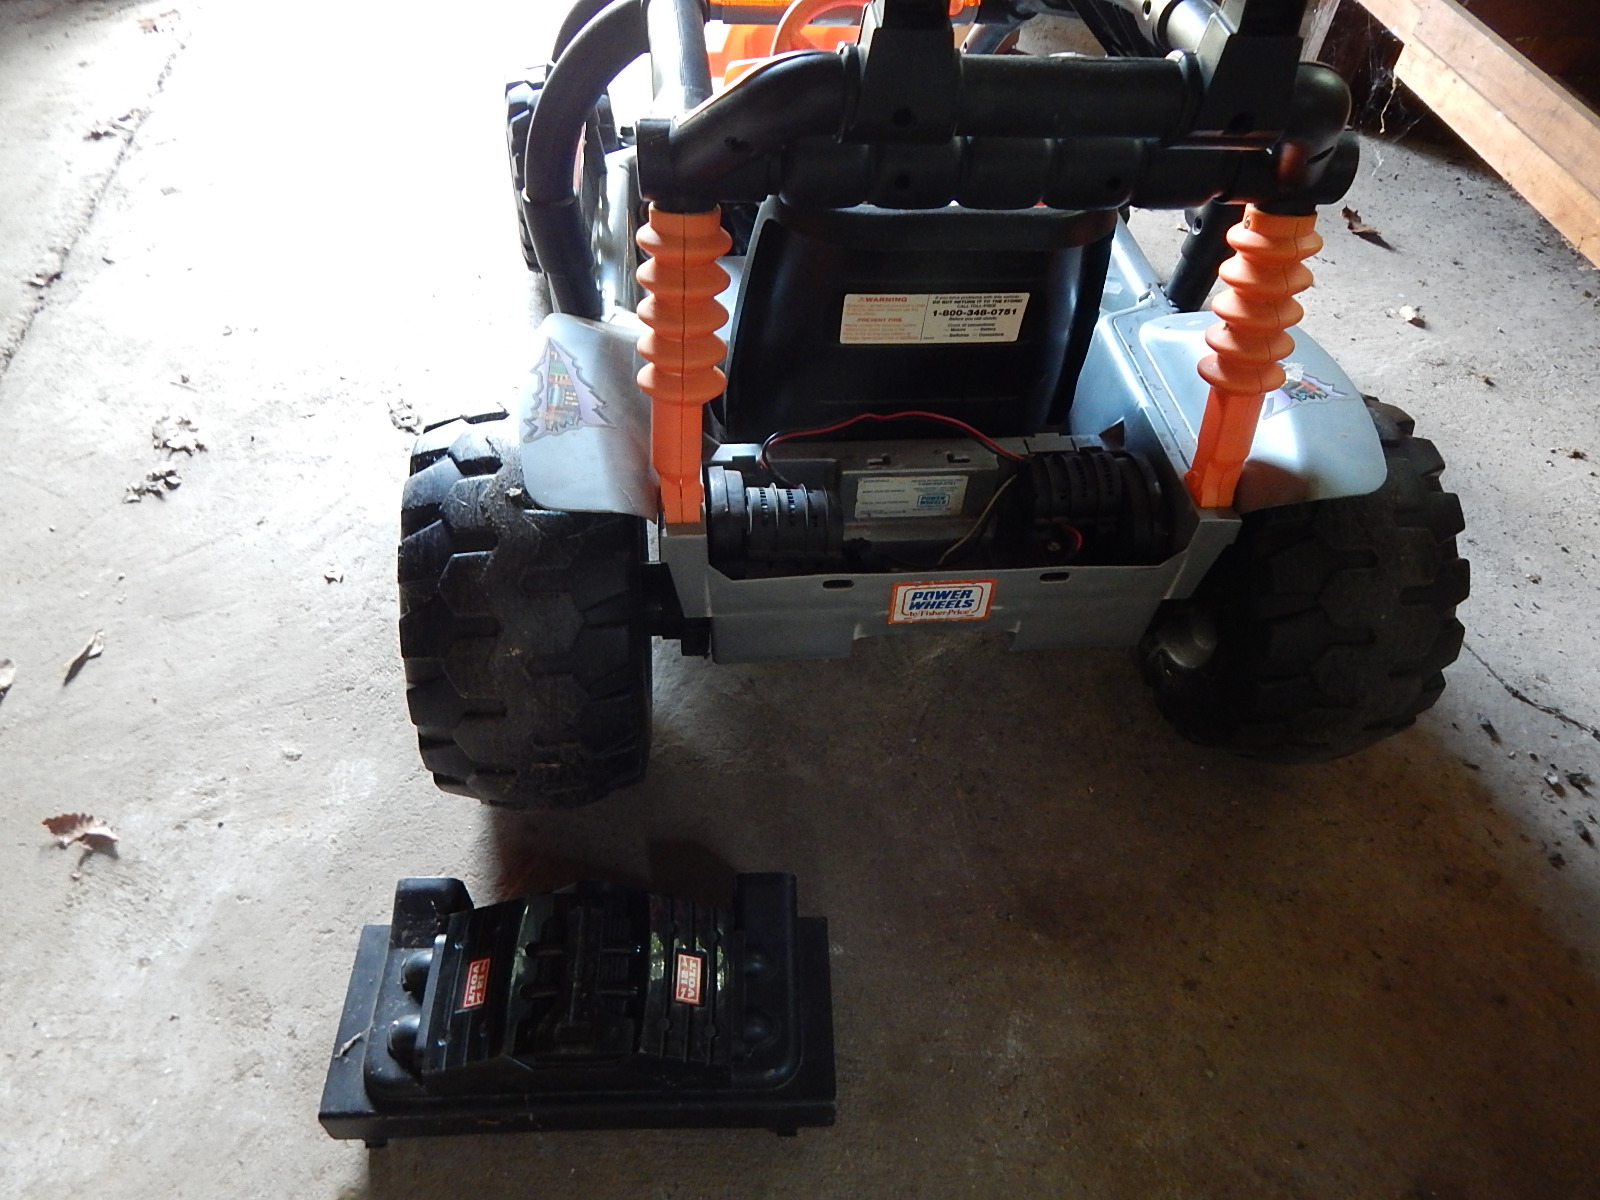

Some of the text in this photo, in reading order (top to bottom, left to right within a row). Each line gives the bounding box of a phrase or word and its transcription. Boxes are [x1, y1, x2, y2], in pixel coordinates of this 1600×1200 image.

[912, 590, 973, 601] POWER
[909, 599, 974, 610] WHEELS
[468, 964, 480, 1002] VOLT
[680, 969, 688, 985] 12
[687, 959, 696, 998] VOLT
